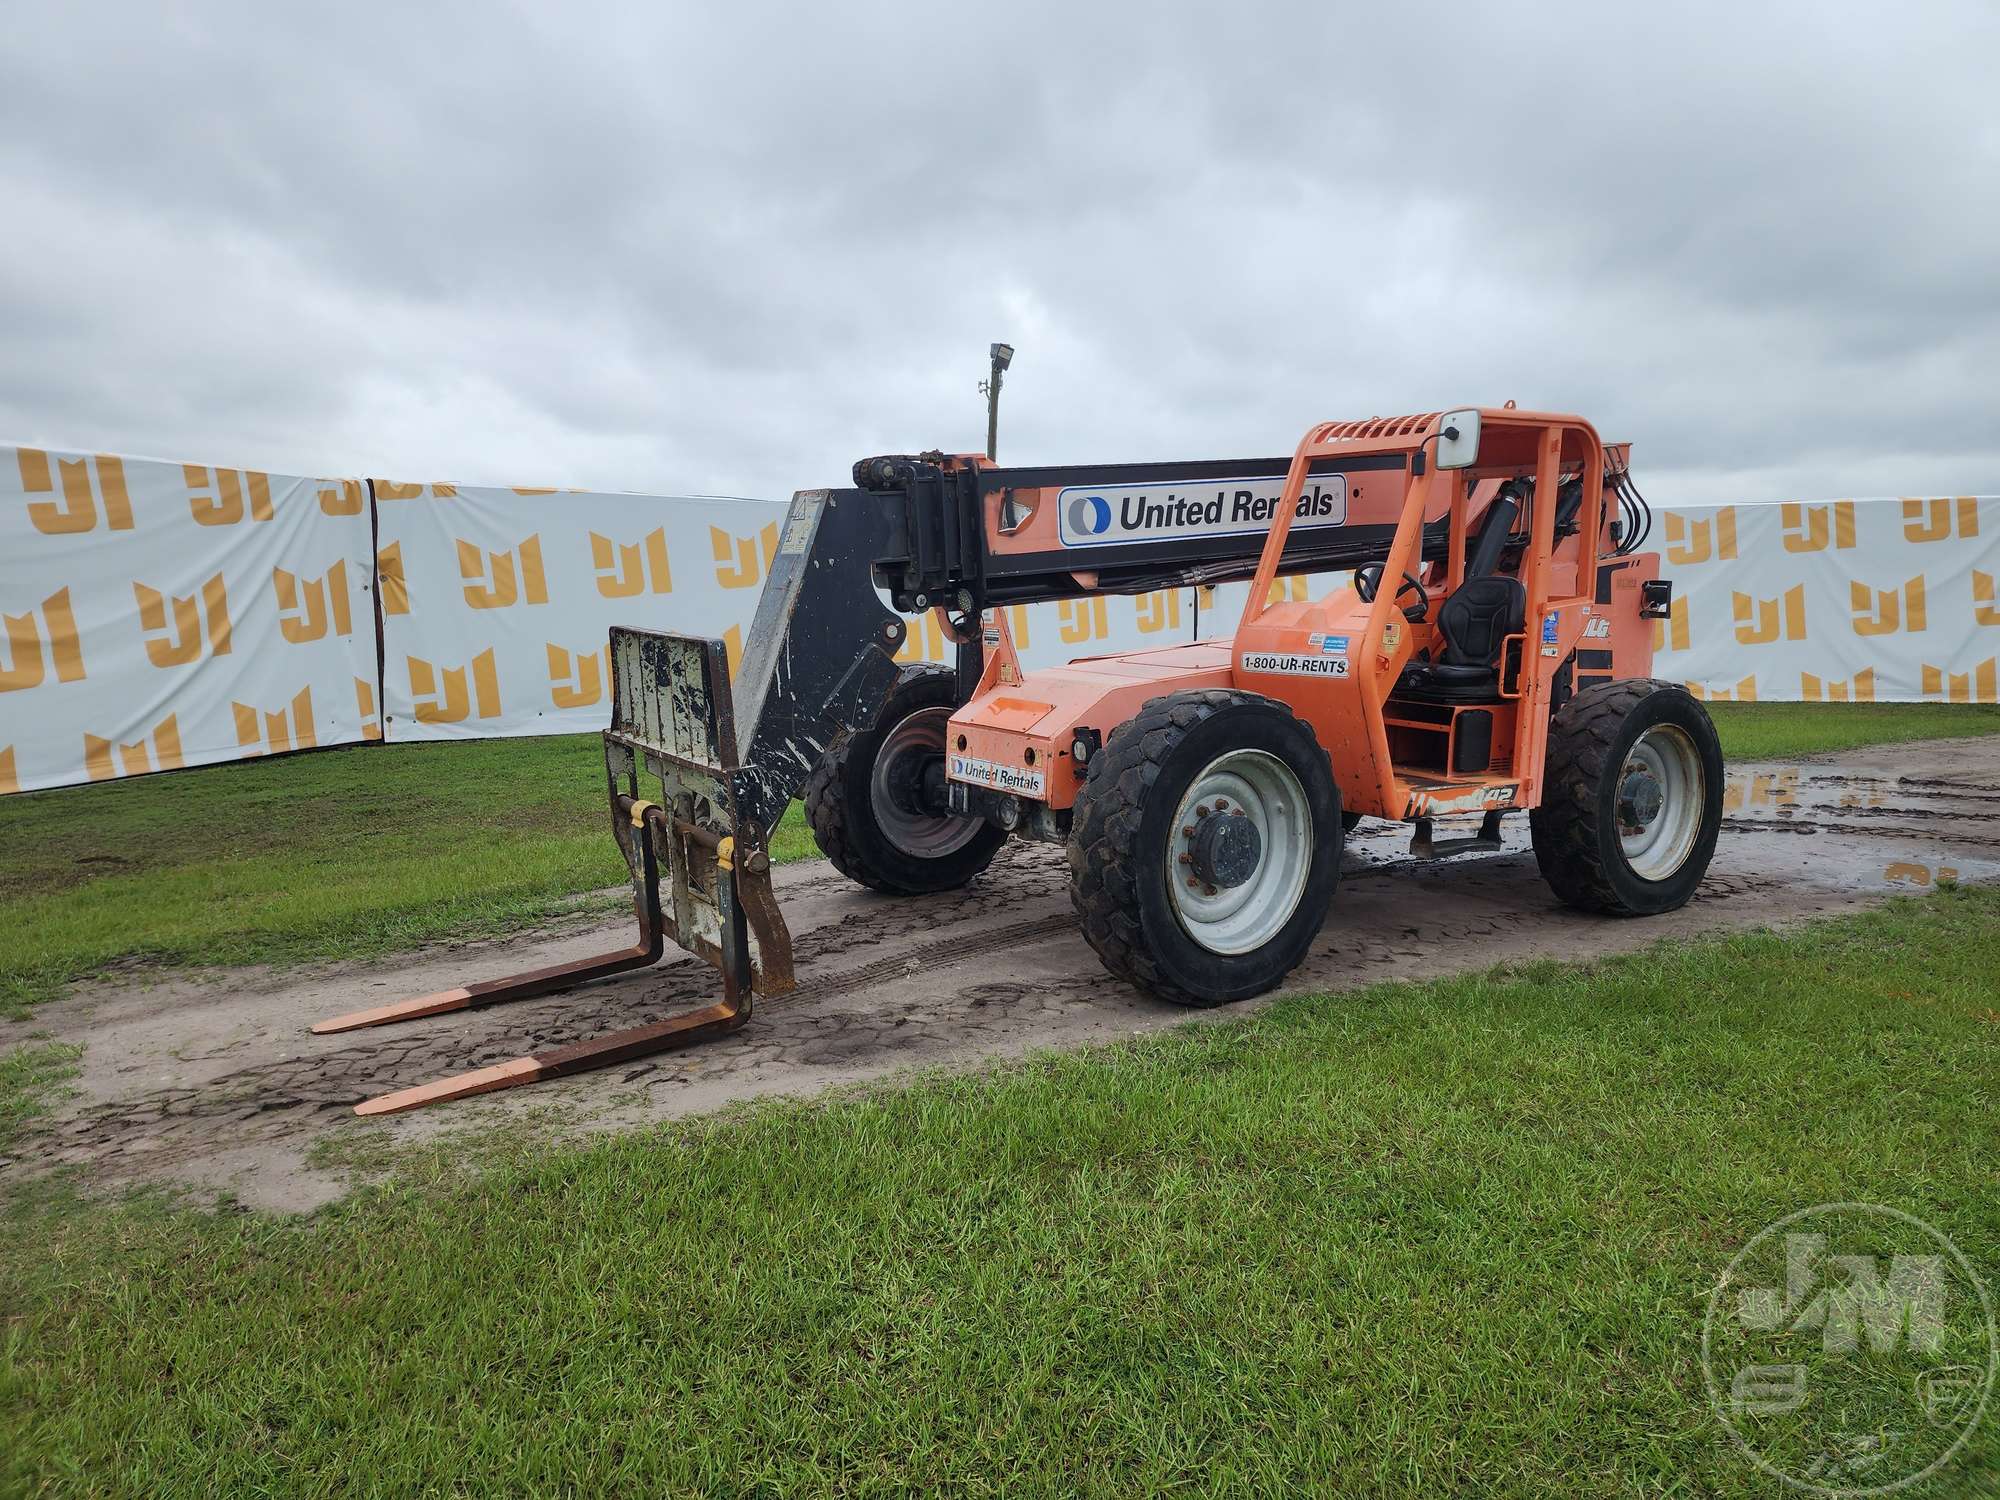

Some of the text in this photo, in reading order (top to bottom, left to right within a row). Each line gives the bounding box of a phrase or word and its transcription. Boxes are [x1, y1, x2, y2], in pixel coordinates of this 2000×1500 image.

[1120, 486, 1333, 530] United Renals
[1244, 656, 1346, 674] 1-800-UR-RENTS
[965, 762, 1040, 791] United Rentals
